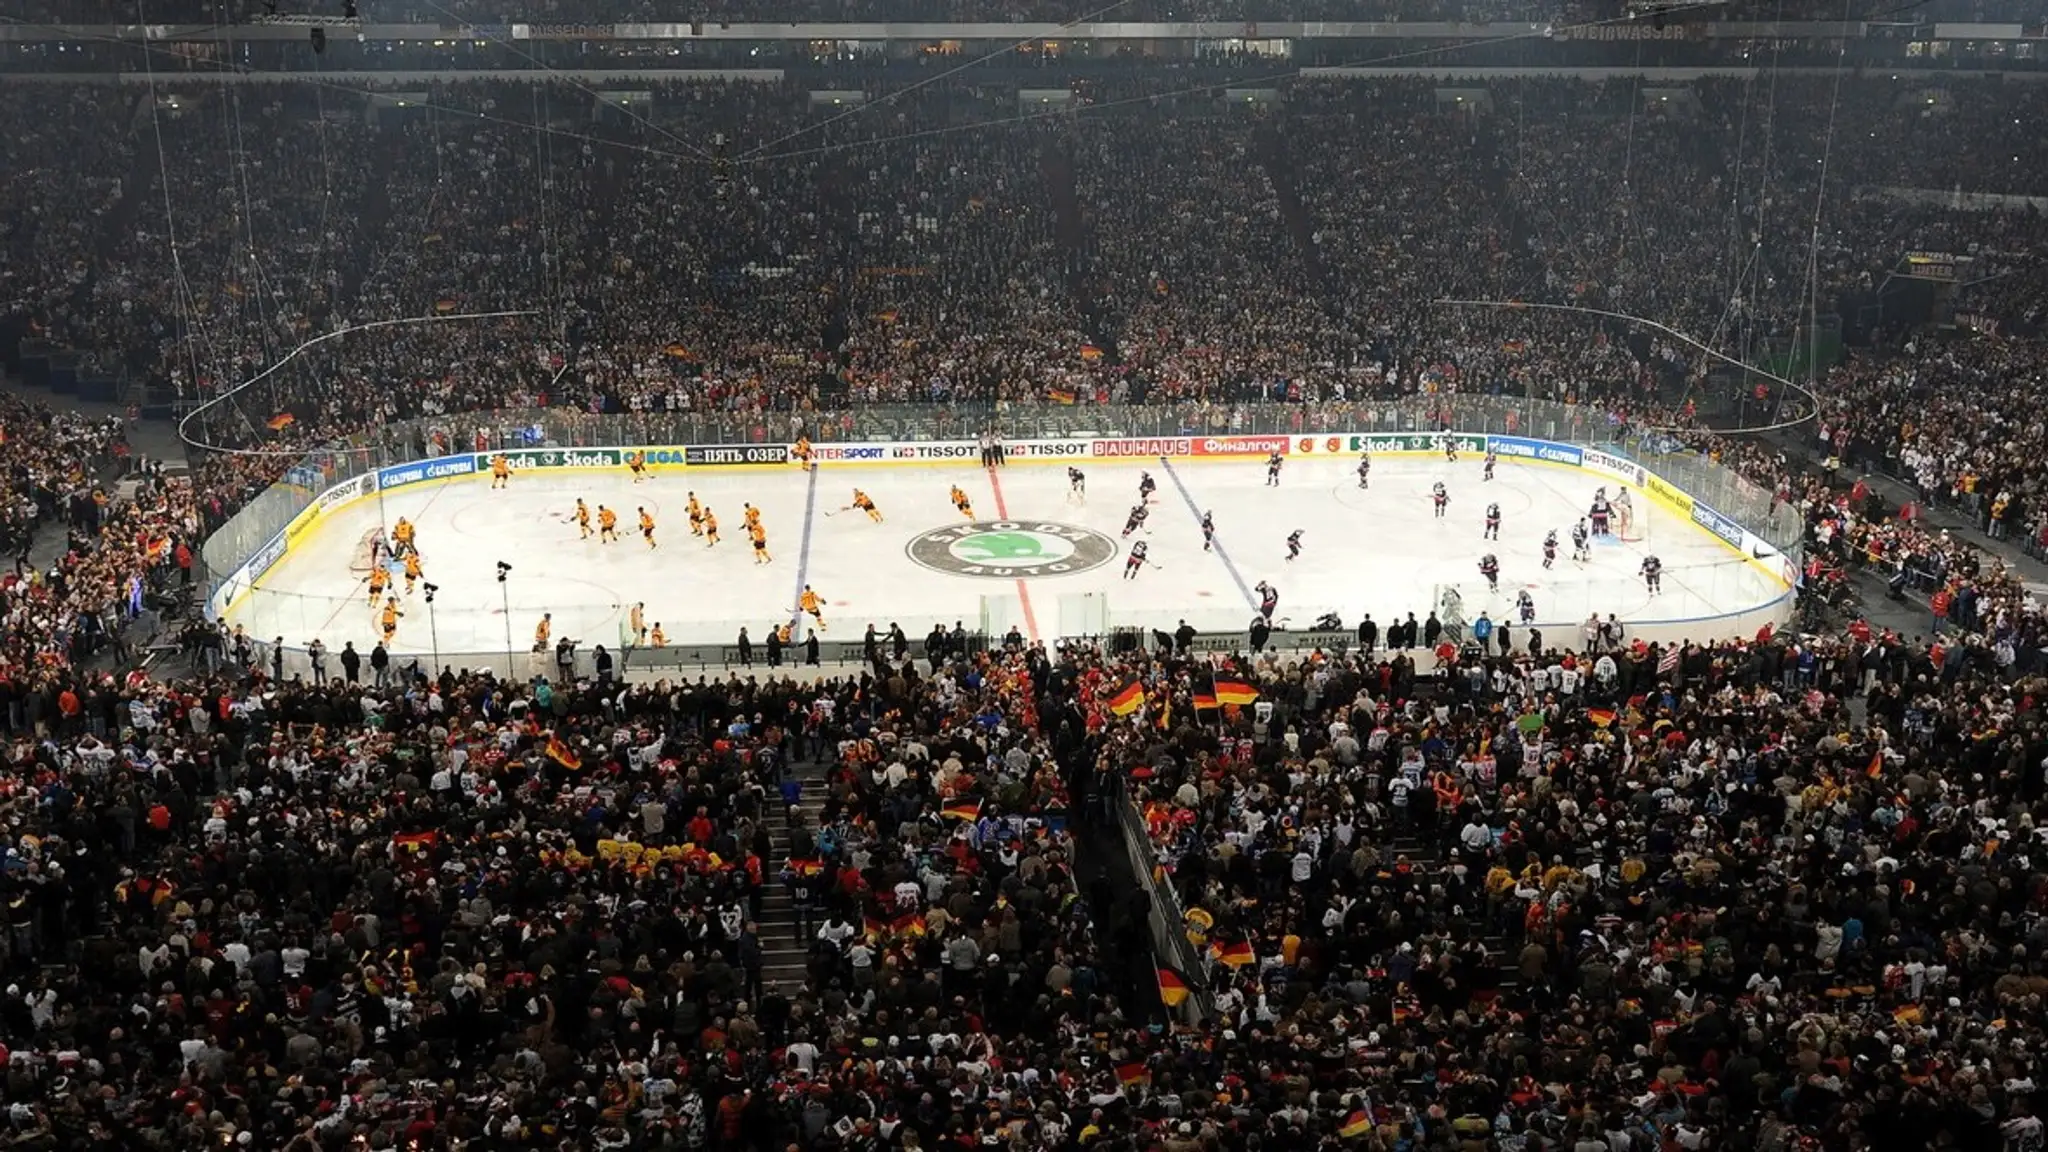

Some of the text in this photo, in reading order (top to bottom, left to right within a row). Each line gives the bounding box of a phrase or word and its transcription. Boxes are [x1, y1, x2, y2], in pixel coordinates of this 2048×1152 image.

[1028, 443, 1086, 455] TISSOT
[1094, 440, 1188, 455] BAUHAUS
[1357, 435, 1404, 450] Škoda
[562, 449, 613, 467] Škoda
[623, 450, 684, 464] OEGA
[704, 449, 742, 463] ПЯТЬ
[746, 447, 786, 462] ОЗЕР
[806, 447, 885, 459] NTERSPORT
[917, 446, 976, 457] TISSOT
[960, 563, 1073, 576] AUTO
[795, 887, 808, 899] 10
